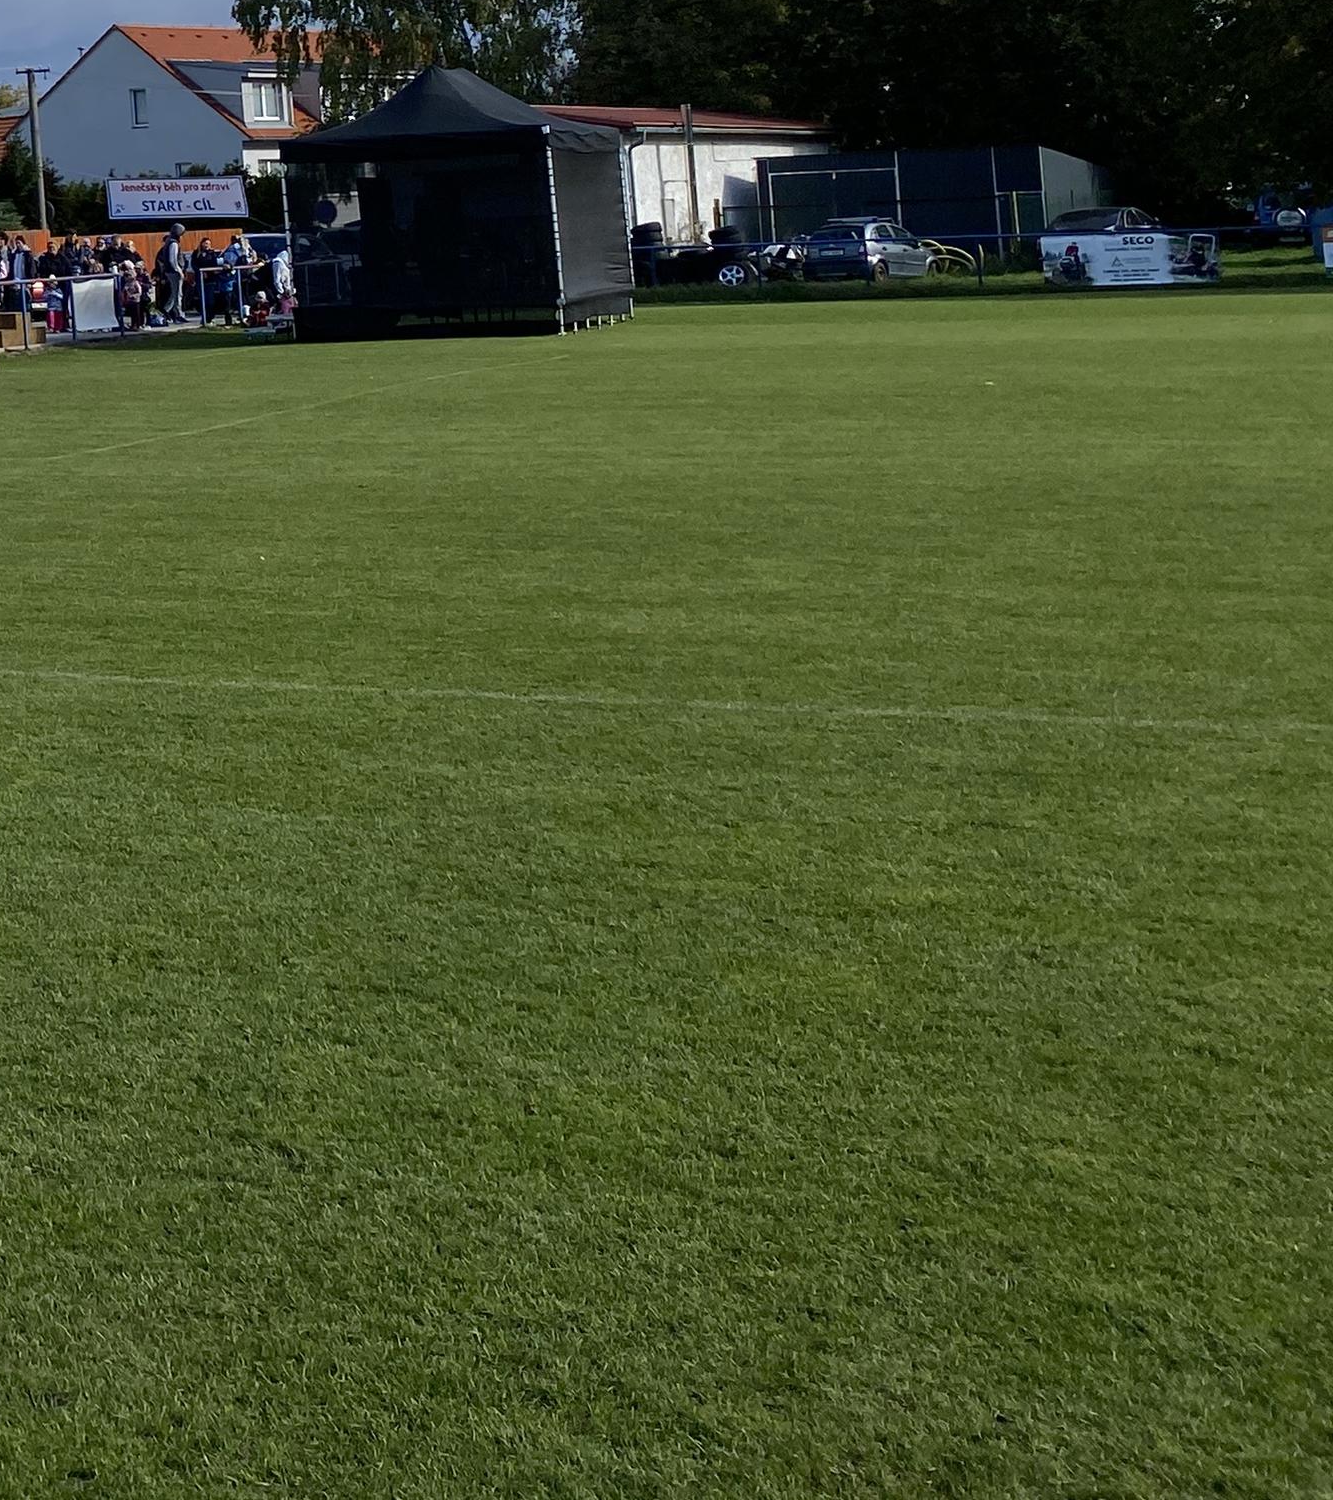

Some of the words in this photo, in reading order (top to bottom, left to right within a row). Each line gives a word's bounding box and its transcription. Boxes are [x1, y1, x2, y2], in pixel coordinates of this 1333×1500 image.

[120, 182, 162, 194] Jenečský
[164, 182, 181, 191] běh
[183, 184, 198, 194] pro
[142, 200, 183, 212] START
[193, 197, 215, 211] CÍL
[1122, 236, 1154, 245] SECO
